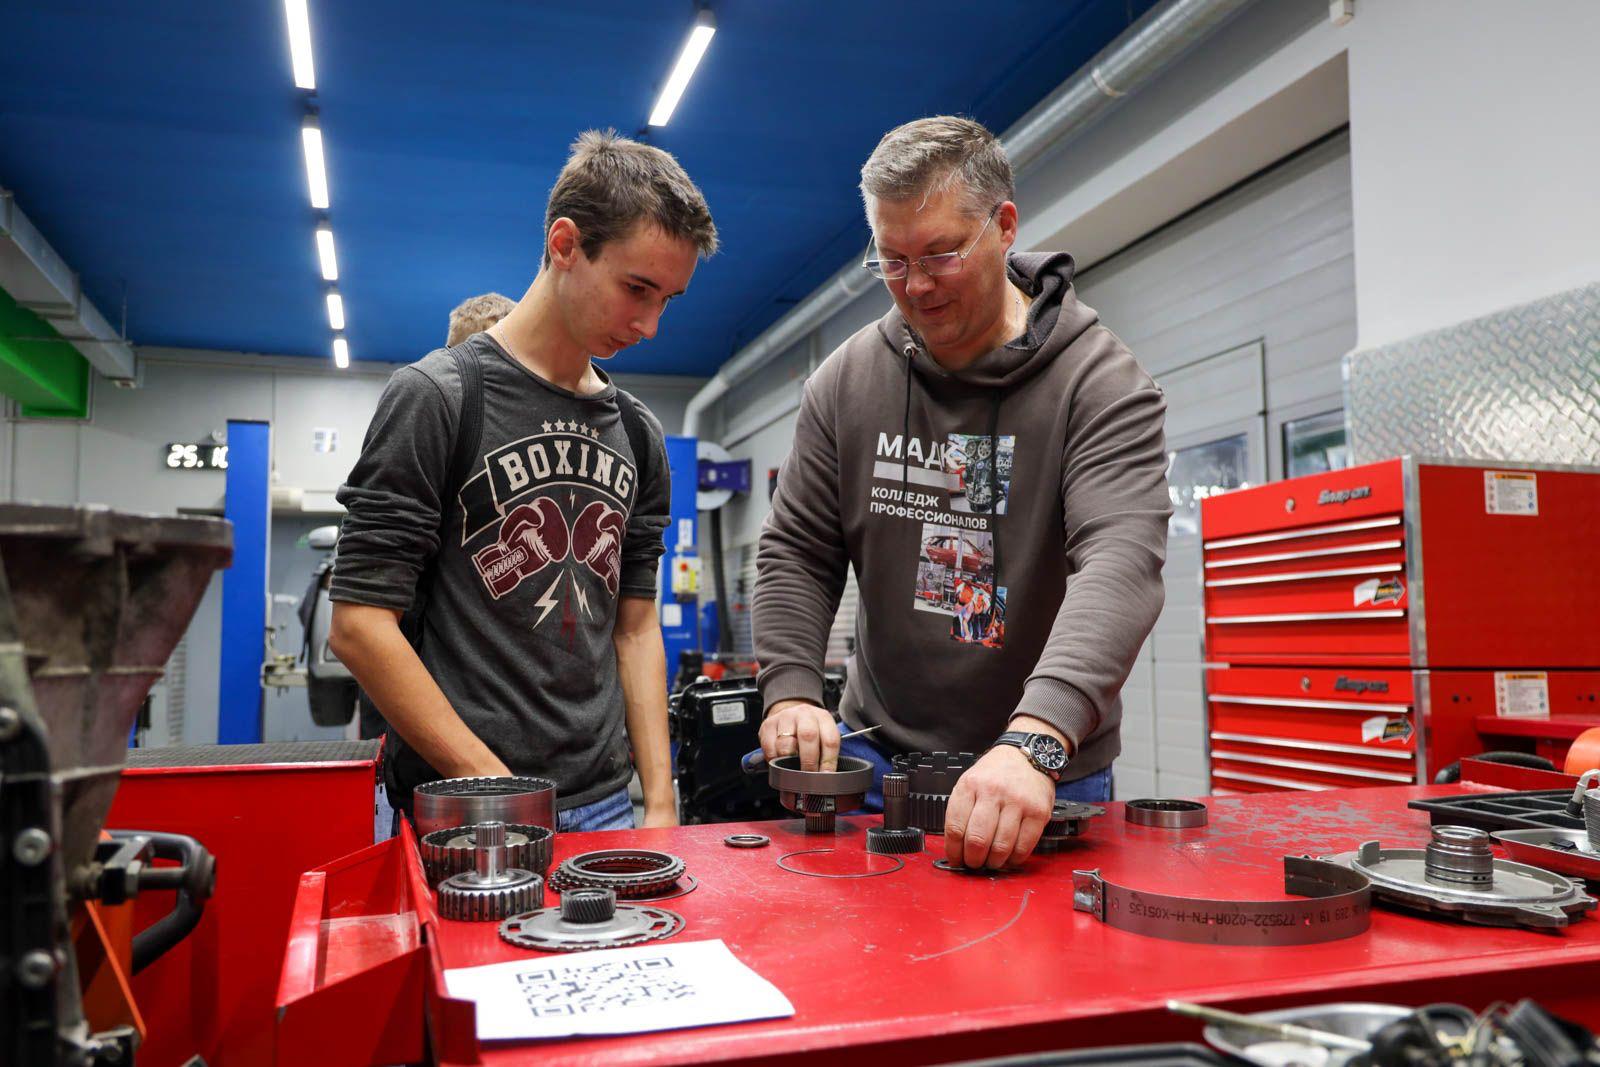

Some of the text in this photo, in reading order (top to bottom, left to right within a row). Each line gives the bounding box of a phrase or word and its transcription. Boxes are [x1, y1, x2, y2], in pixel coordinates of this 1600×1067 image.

[498, 439, 634, 500] BOXING
[871, 486, 940, 507] КОЛЛЕДЖ
[869, 501, 988, 530] ПРОФЕССИОНАЛОВ
